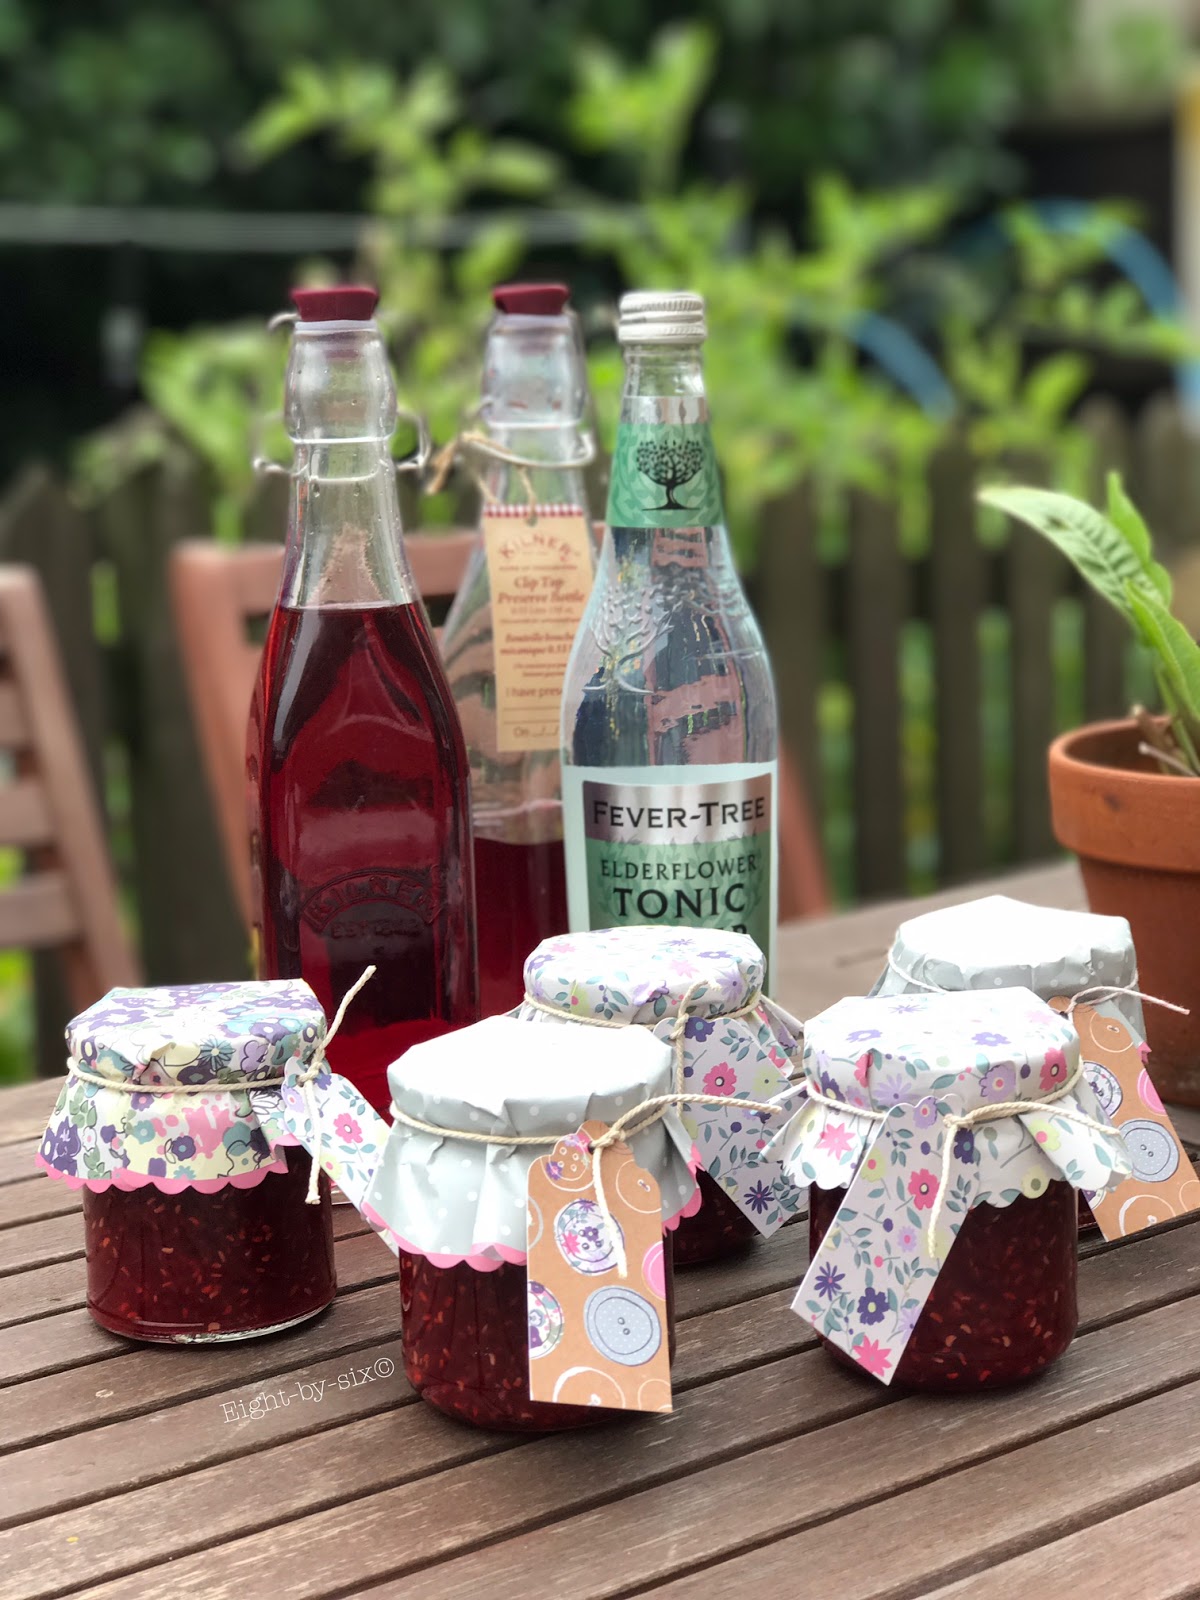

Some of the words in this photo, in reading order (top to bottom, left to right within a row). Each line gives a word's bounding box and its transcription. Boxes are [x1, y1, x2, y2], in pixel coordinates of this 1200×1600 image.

[512, 688, 536, 697] have
[593, 797, 766, 829] FEVER-TREE
[601, 854, 757, 880] ELDERFLOWER
[613, 883, 745, 919] TONIC
